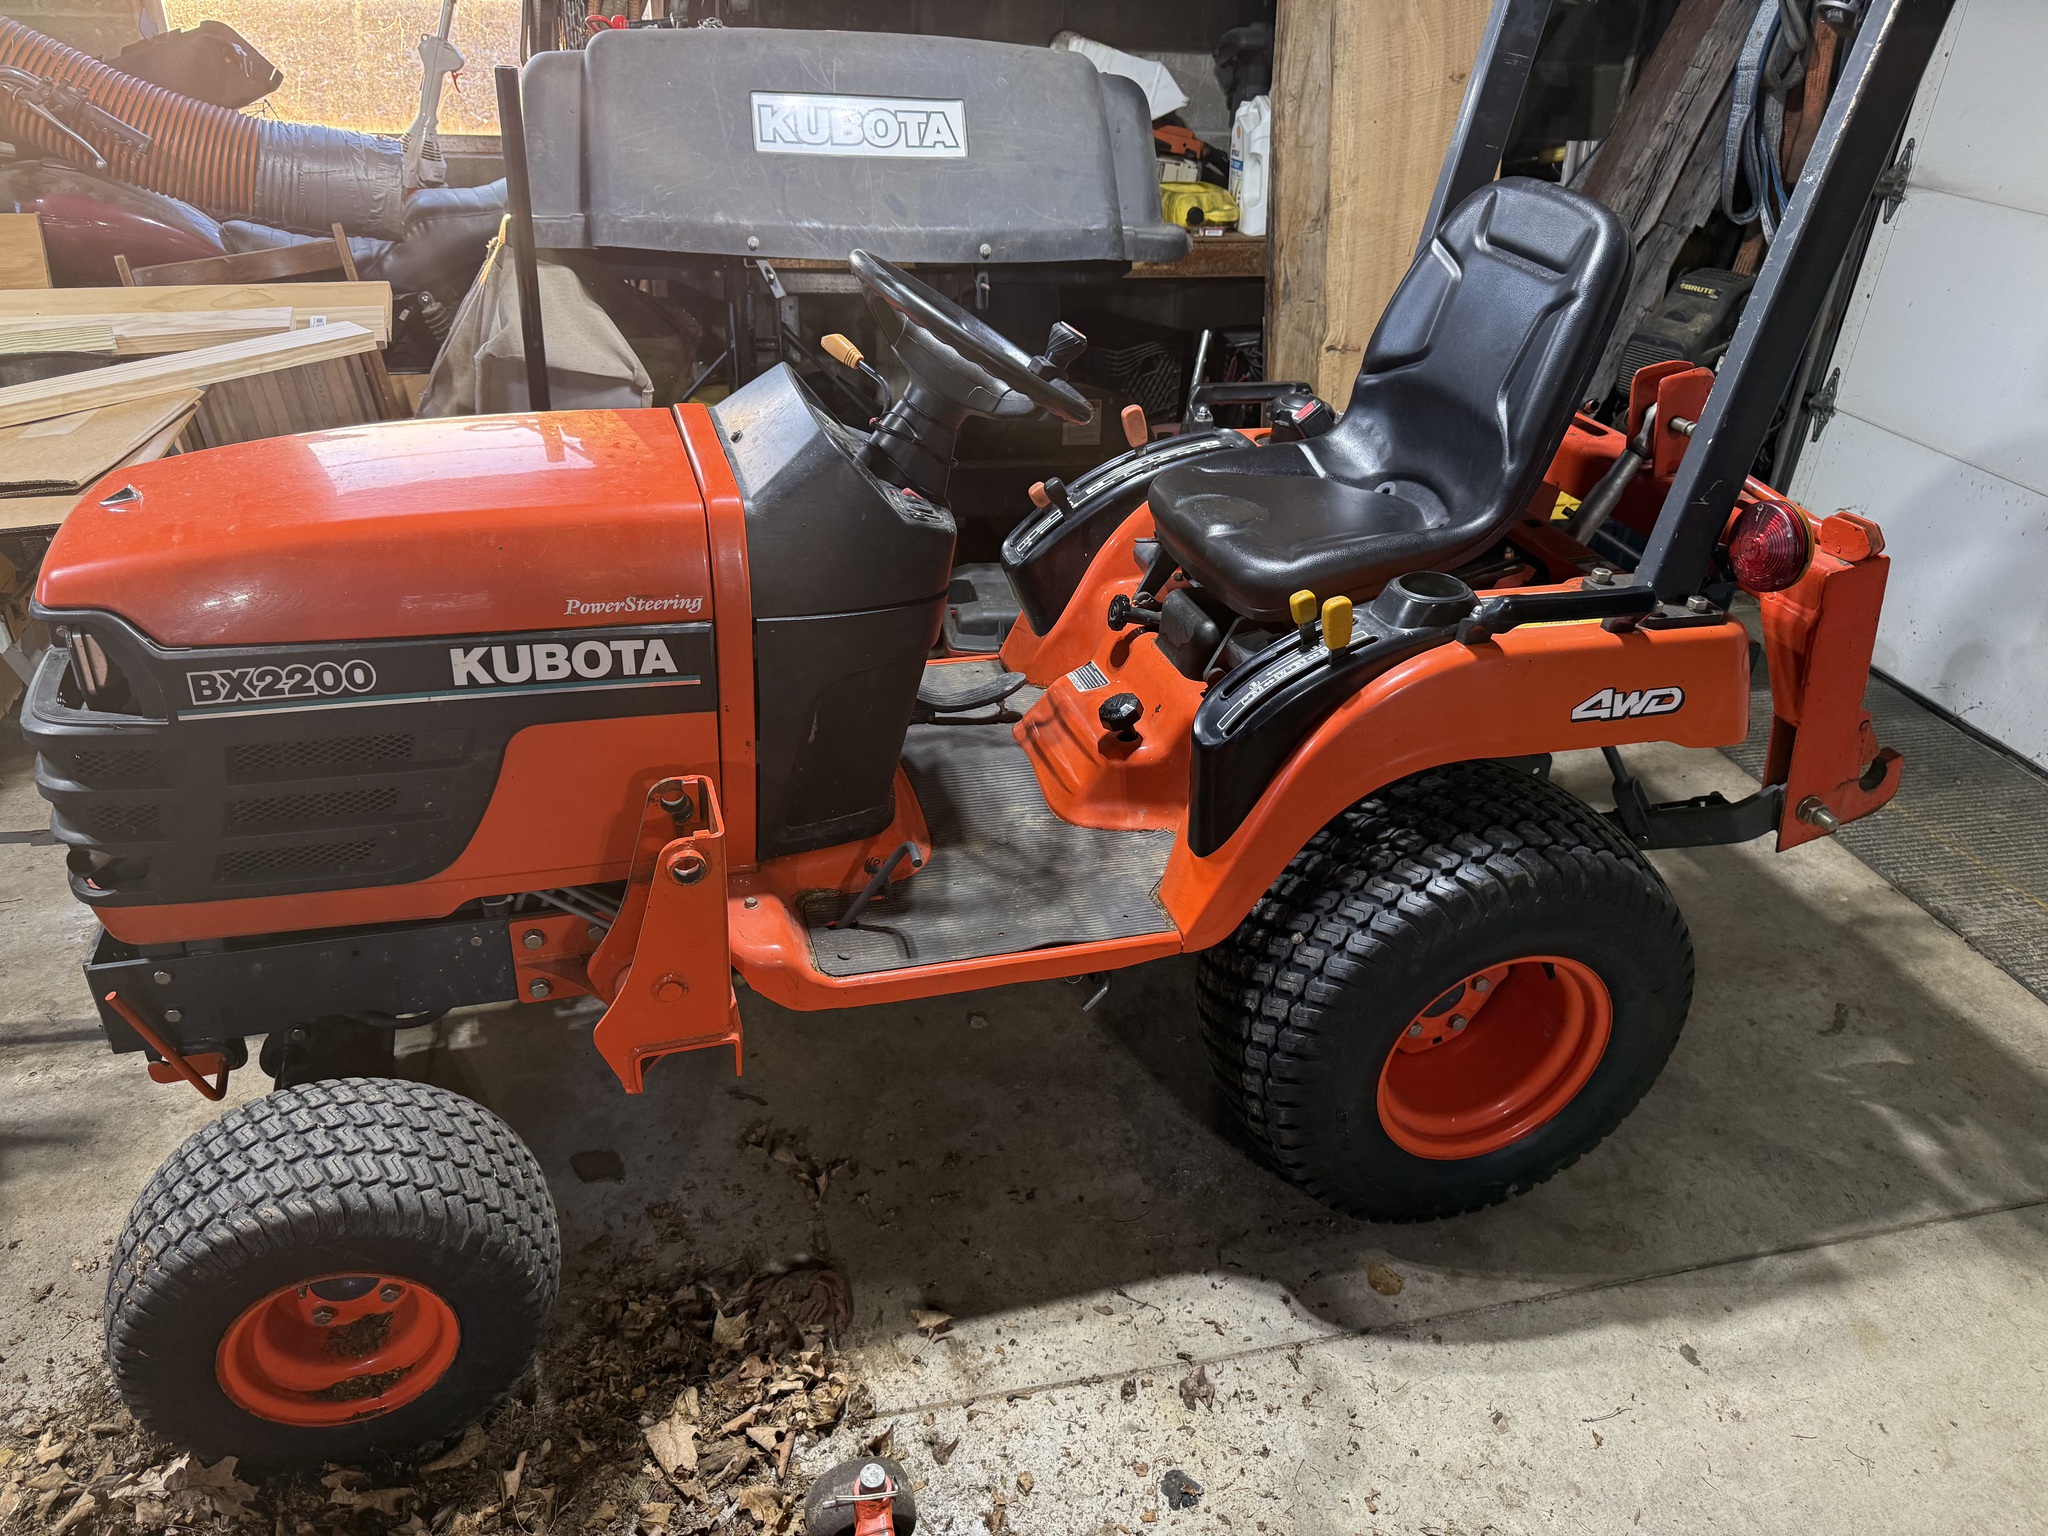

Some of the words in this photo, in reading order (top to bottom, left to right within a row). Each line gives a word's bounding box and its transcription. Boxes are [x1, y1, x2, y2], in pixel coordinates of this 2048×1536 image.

[757, 104, 960, 149] KUBOTA
[1684, 283, 1716, 295] BRUTE
[563, 593, 704, 616] PowerSteering
[449, 638, 679, 686] KUBOTA
[186, 659, 377, 706] BX2200
[1570, 686, 1686, 722] 4WD
